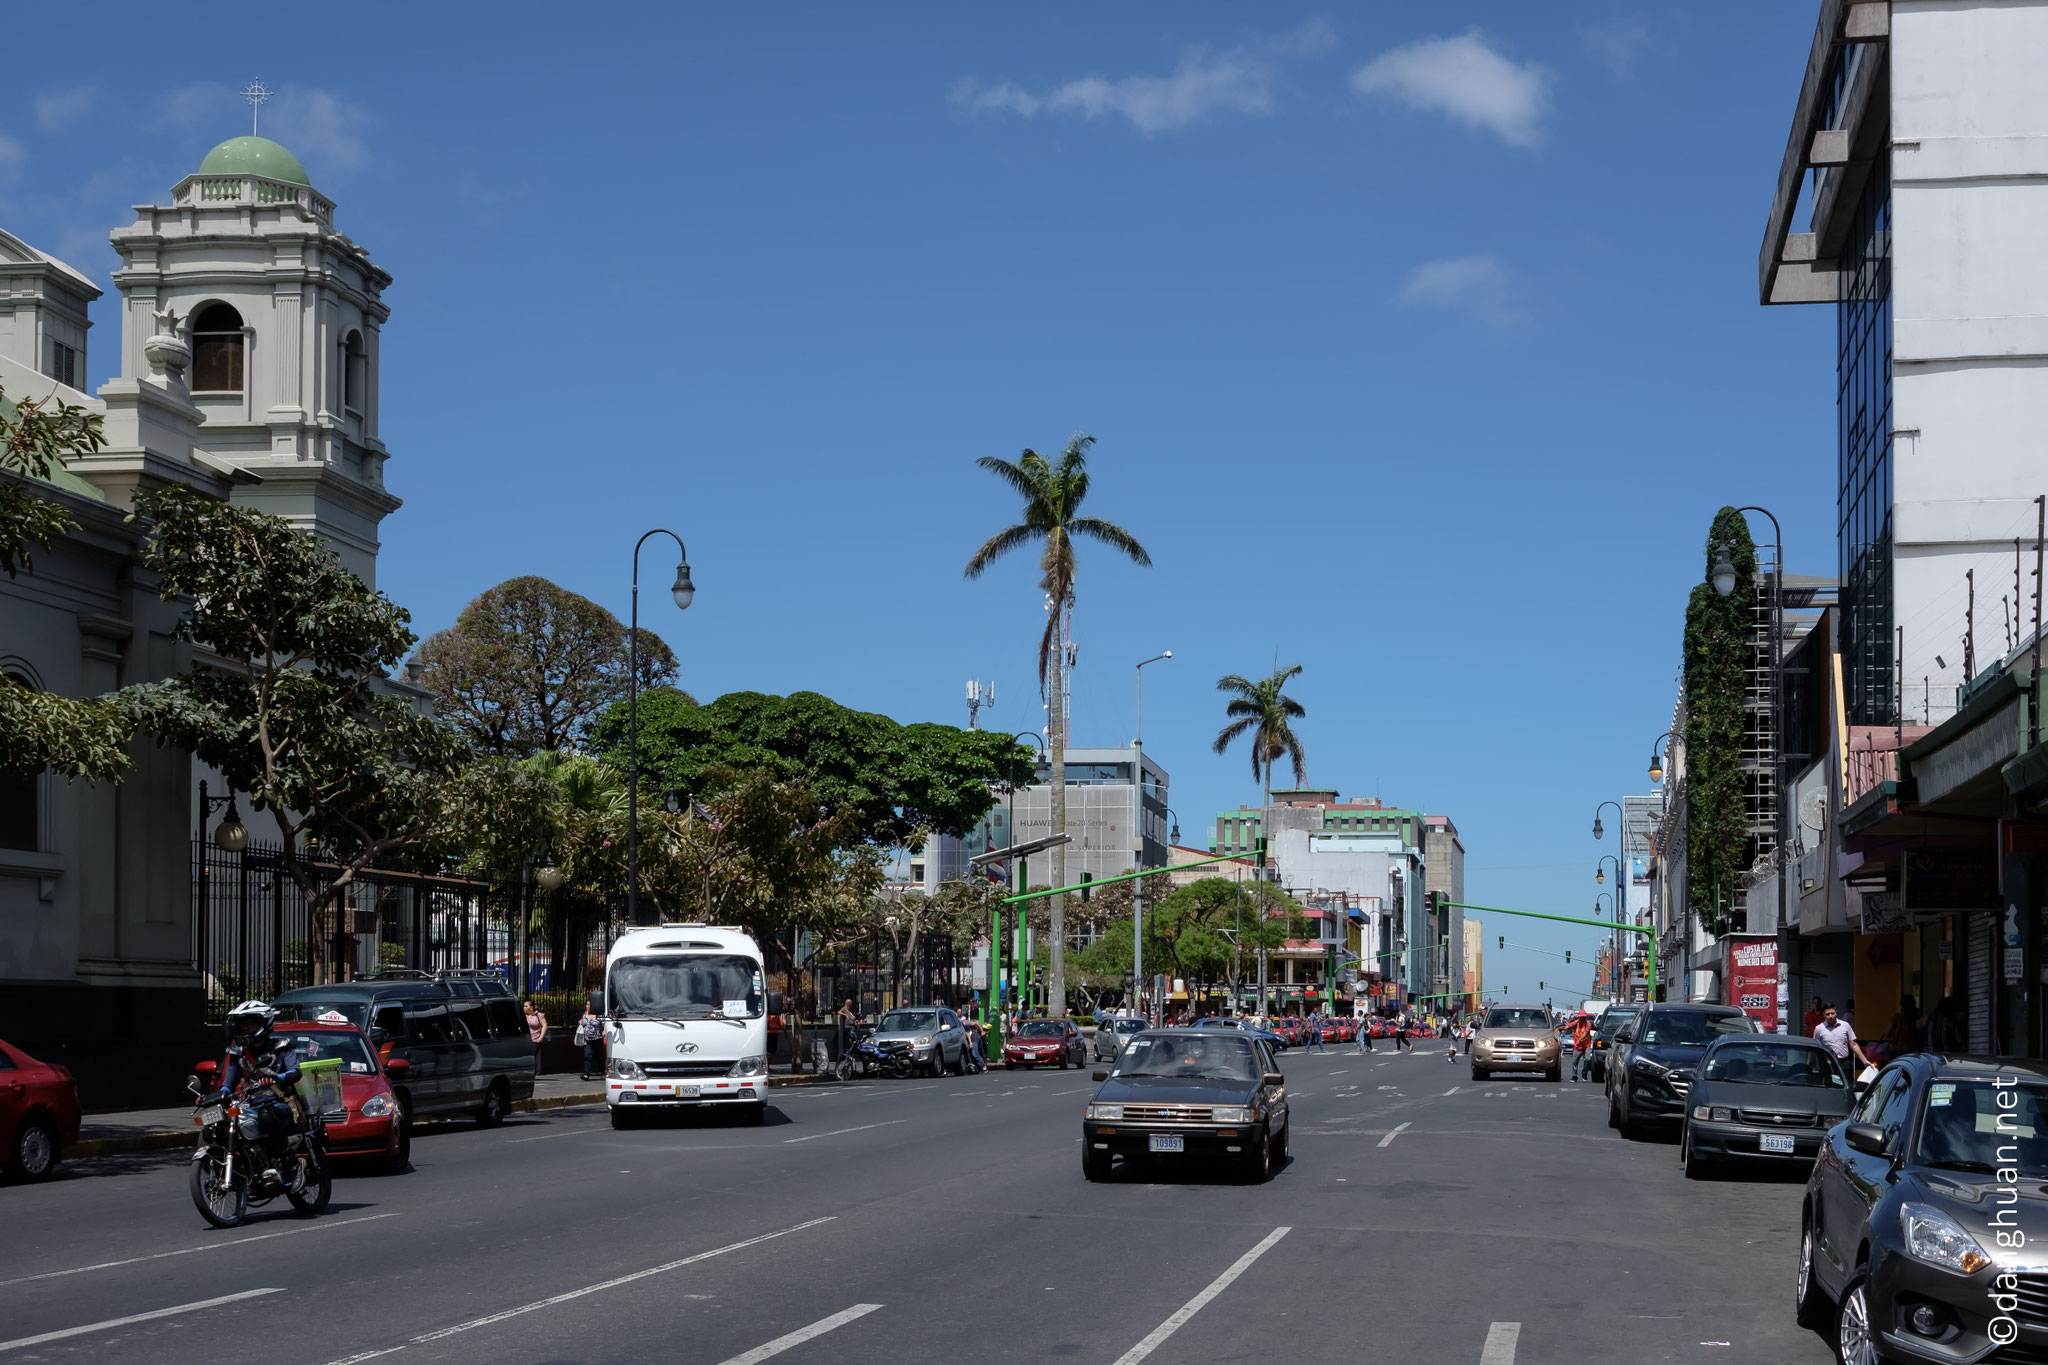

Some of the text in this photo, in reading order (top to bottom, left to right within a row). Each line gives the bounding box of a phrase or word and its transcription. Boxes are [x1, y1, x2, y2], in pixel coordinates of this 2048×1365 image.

[1088, 819, 1108, 827] Series
[1744, 941, 1778, 953] COSTA RICA
[1761, 957, 1775, 965] UNO
[1155, 1138, 1182, 1148] 109891
[1765, 1139, 1792, 1149] 563198
